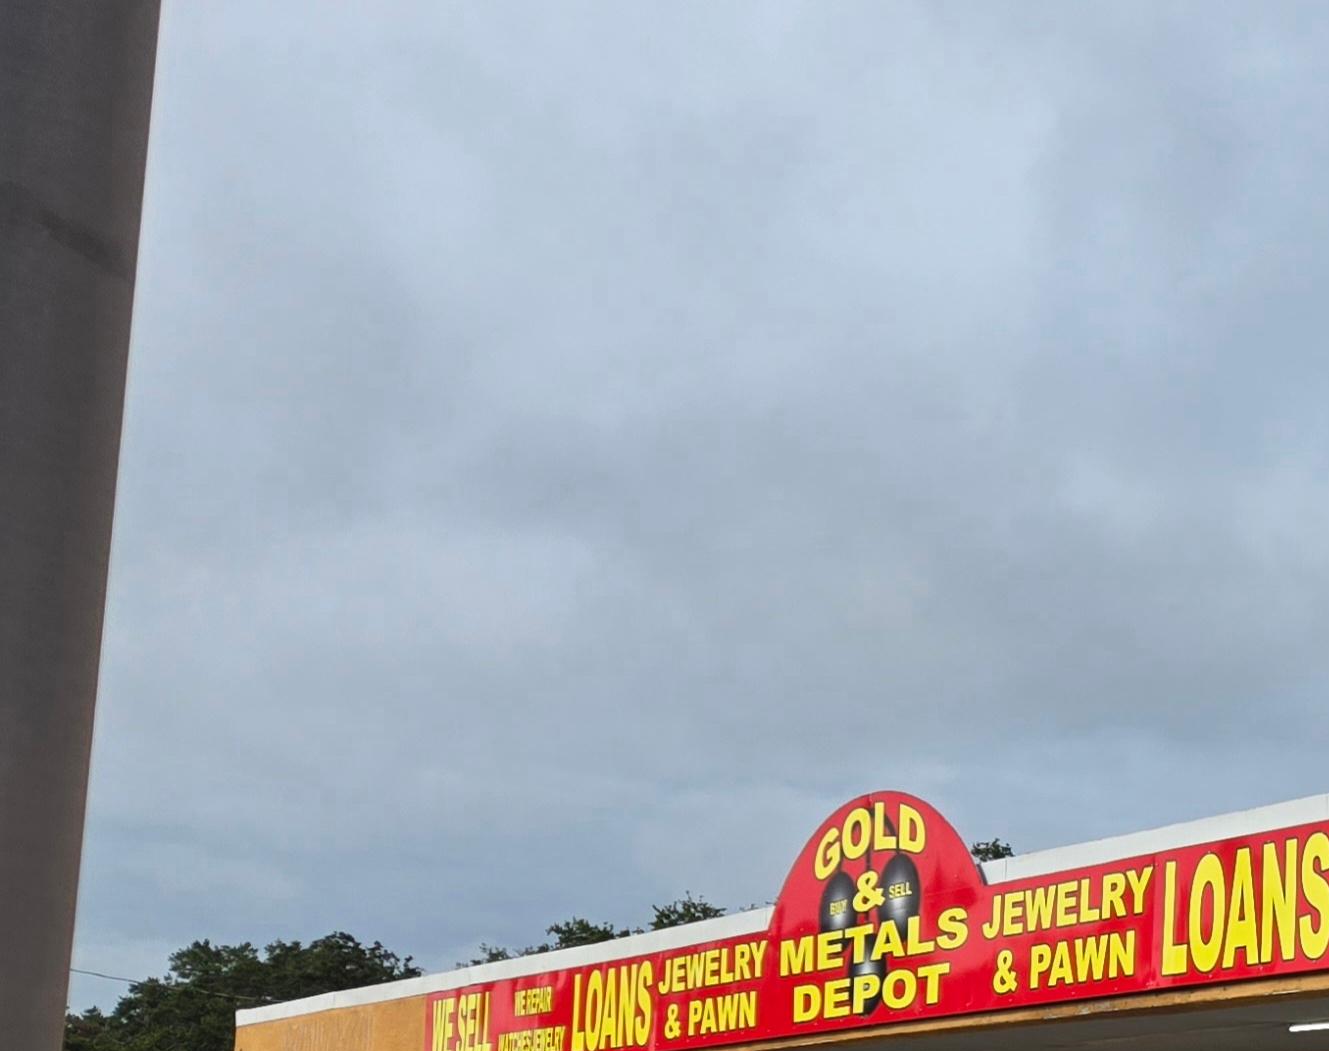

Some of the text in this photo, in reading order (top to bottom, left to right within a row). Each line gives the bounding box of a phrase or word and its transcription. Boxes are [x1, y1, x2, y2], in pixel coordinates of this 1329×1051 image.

[814, 801, 926, 880] GOLD
[829, 898, 848, 916] BUY
[852, 870, 885, 913] &
[888, 881, 913, 899] SELL
[981, 866, 1153, 939] JEWELRY
[658, 940, 768, 995] JEWELRY
[780, 907, 968, 977] METALS
[992, 929, 1136, 994] & PAWN
[514, 986, 553, 1017] WE REPAIR
[664, 990, 757, 1040] & PAWN
[793, 962, 950, 1023] DEPOT
